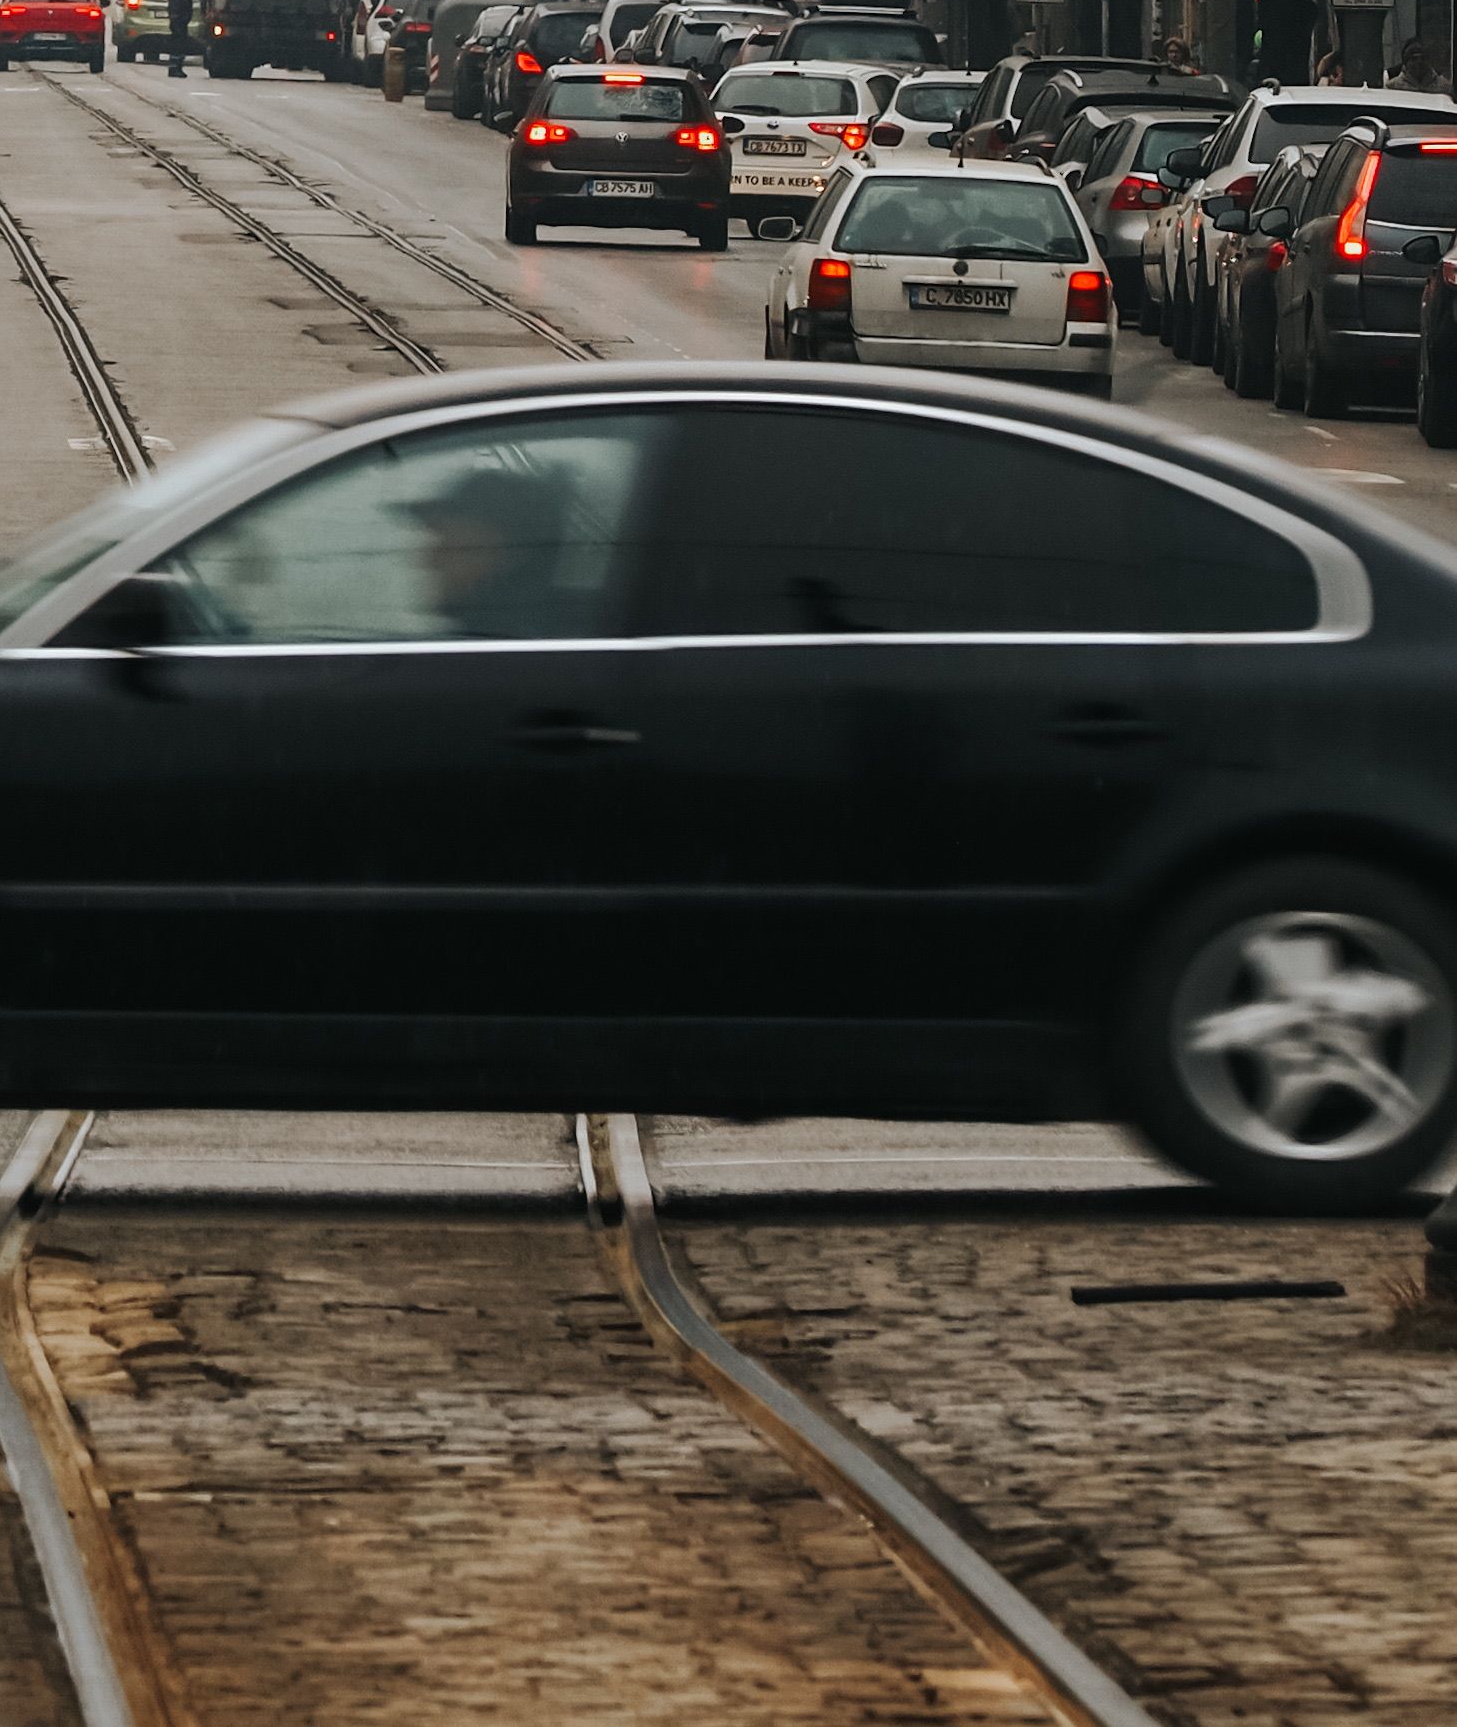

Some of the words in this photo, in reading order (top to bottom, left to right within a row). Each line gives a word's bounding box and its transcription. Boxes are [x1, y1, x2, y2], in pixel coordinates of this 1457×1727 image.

[765, 142, 789, 152] 7673
[745, 175, 759, 184] TO
[762, 176, 775, 185] BE
[777, 177, 785, 186] A
[611, 182, 636, 193] 7575
[926, 287, 937, 303] C
[985, 291, 1006, 307] HX
